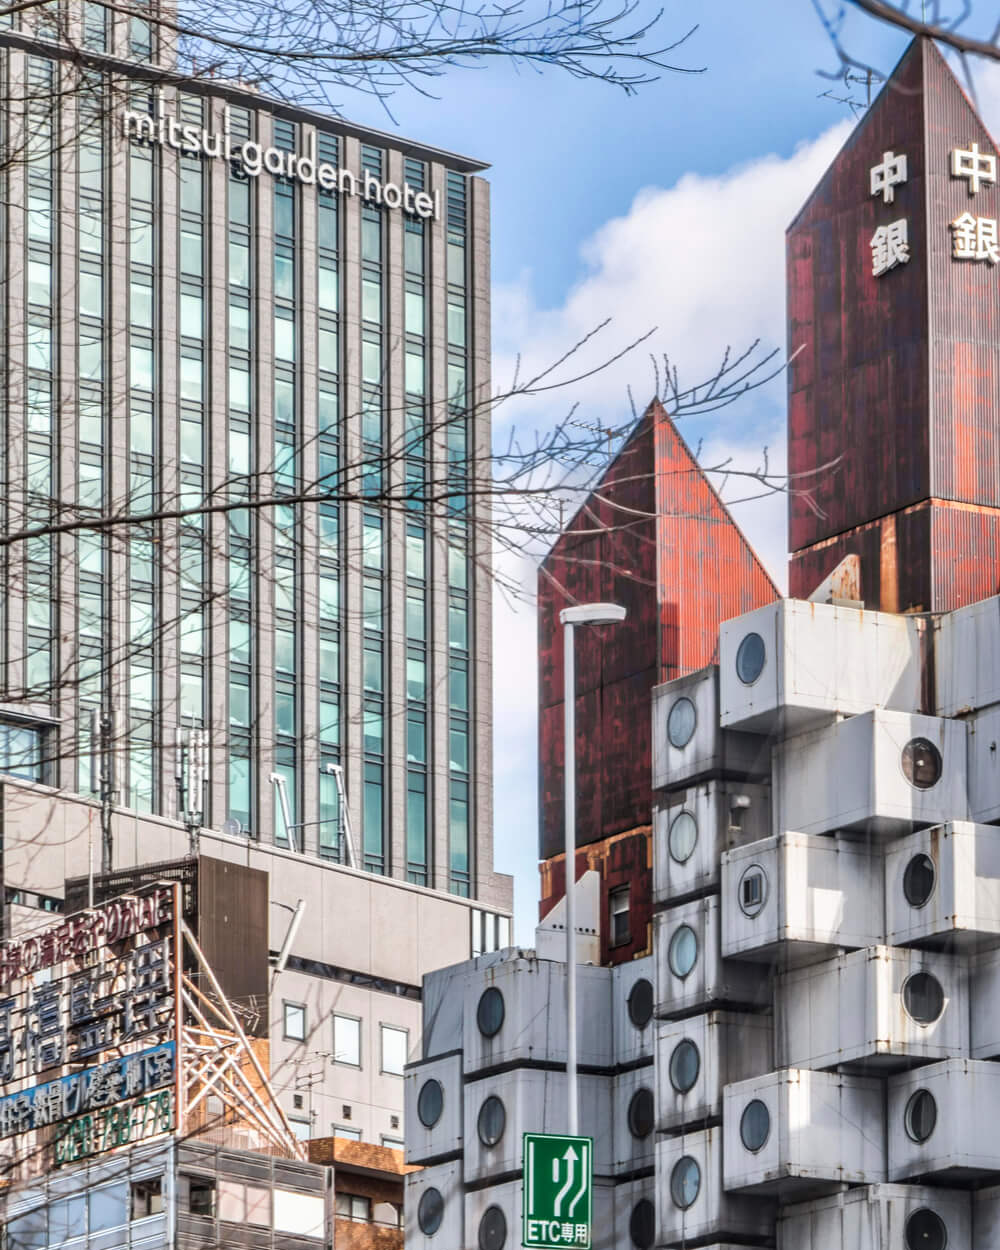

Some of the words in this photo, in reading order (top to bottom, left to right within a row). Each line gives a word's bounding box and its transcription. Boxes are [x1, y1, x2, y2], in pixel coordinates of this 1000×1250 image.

[122, 89, 231, 161] mitsui
[242, 131, 356, 197] garden
[364, 168, 441, 221] hotel
[869, 151, 911, 277] 中銀
[951, 143, 1000, 266] 中銀
[527, 1219, 588, 1244] ETC専用
